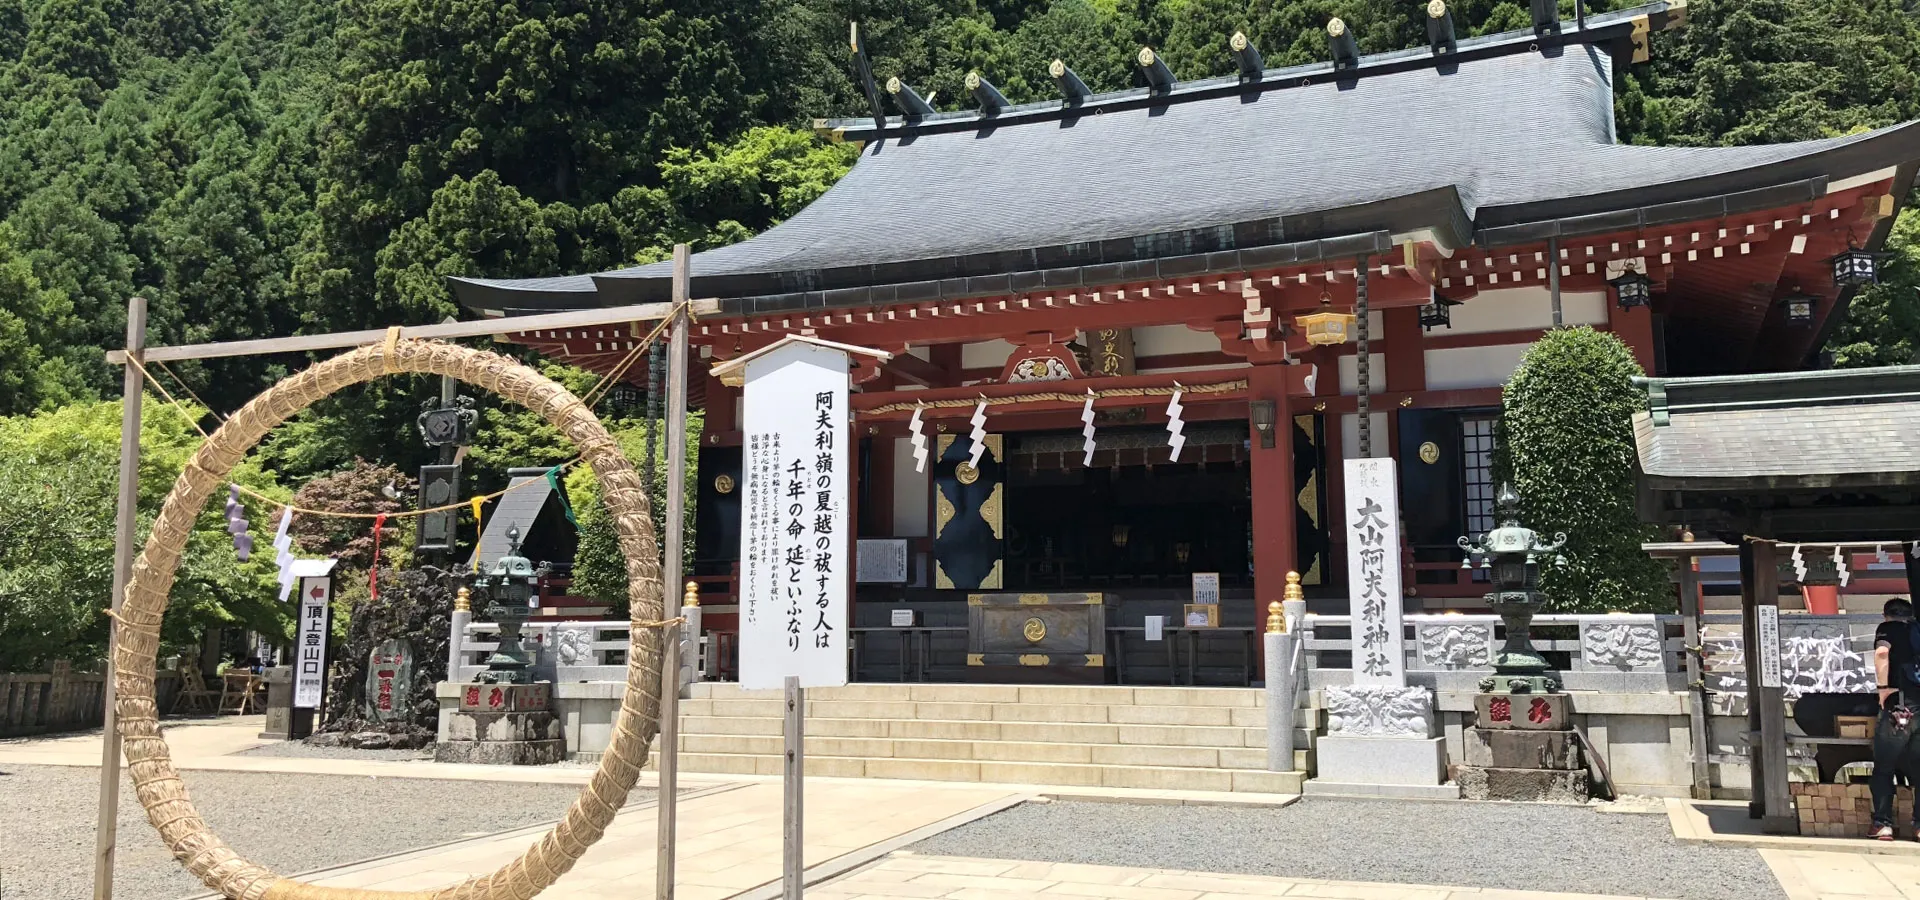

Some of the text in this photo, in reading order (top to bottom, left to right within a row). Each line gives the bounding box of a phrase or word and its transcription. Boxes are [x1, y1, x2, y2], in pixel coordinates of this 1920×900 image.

[813, 390, 835, 648] 阿夫利嶺の夏越の祓する人は
[1352, 497, 1393, 677] 大山阿夫利神社
[303, 605, 324, 675] 頂上登山口
